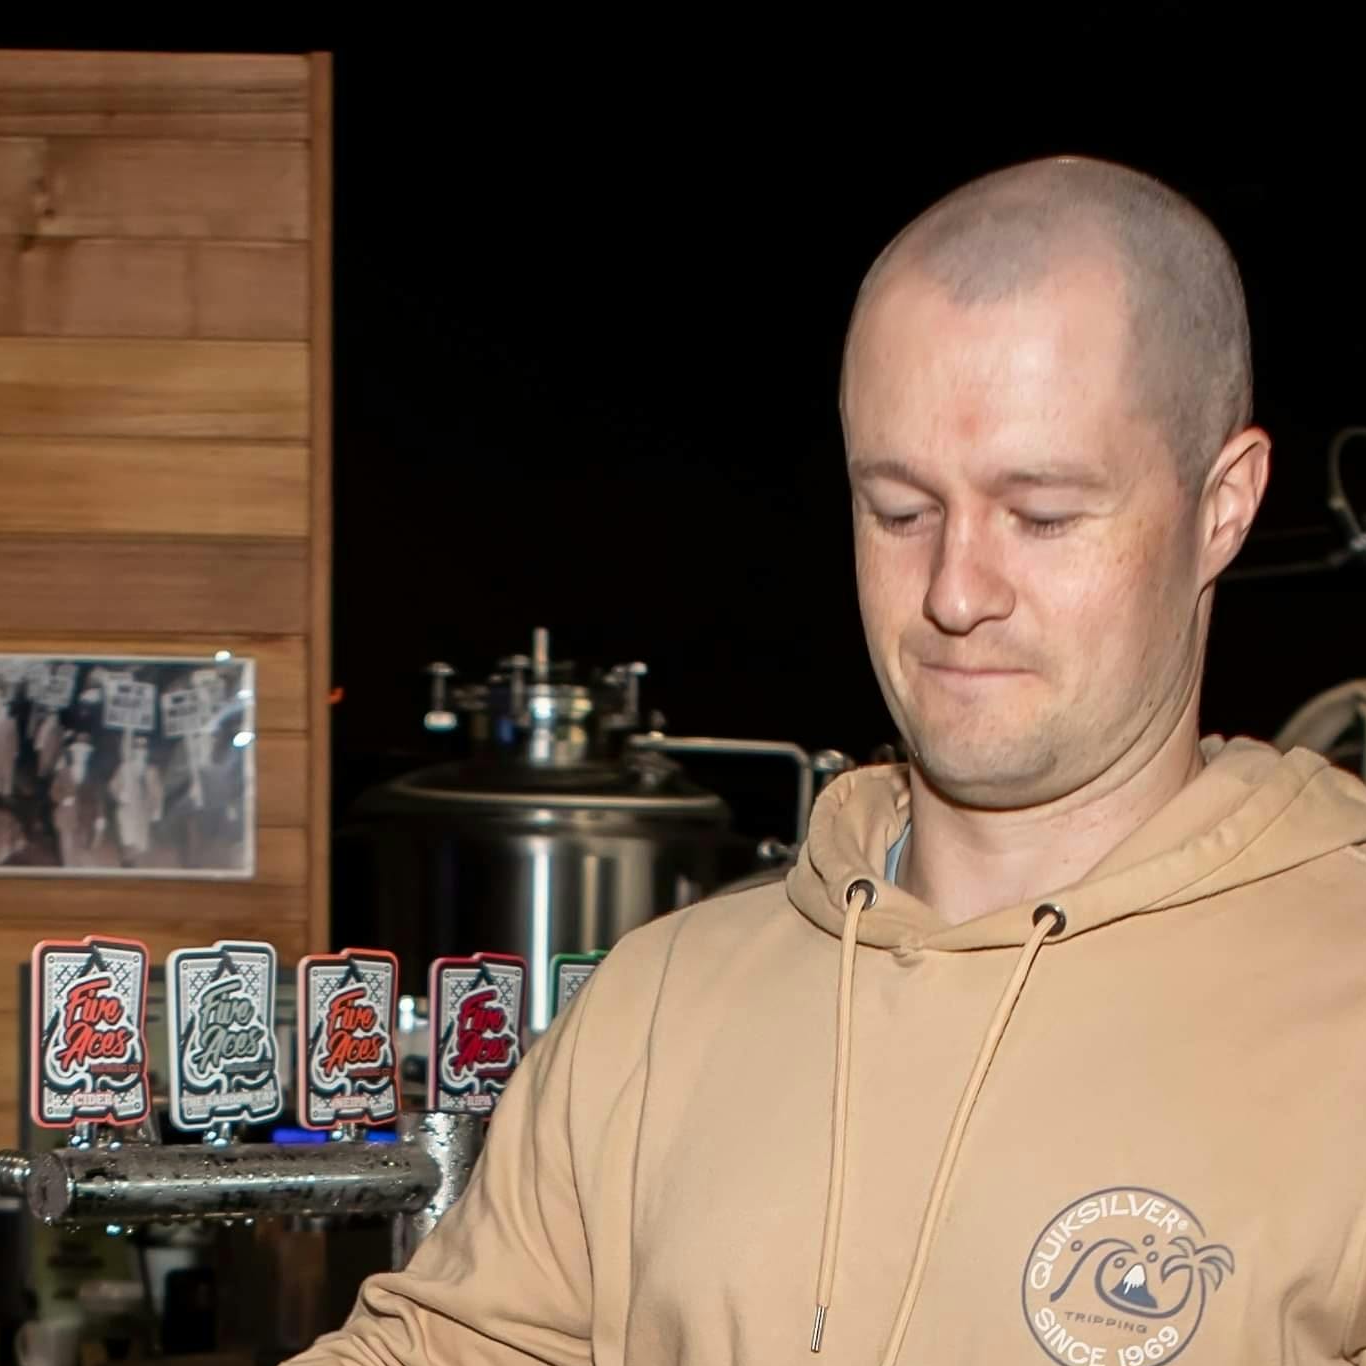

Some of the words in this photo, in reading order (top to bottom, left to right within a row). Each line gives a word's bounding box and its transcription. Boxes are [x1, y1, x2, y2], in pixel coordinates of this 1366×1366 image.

[65, 978, 122, 1028] Five
[198, 979, 254, 1032] Five
[327, 987, 377, 1035] Five
[57, 1023, 133, 1072] Aces
[191, 1026, 265, 1074] Aces
[320, 1031, 385, 1079] Aces
